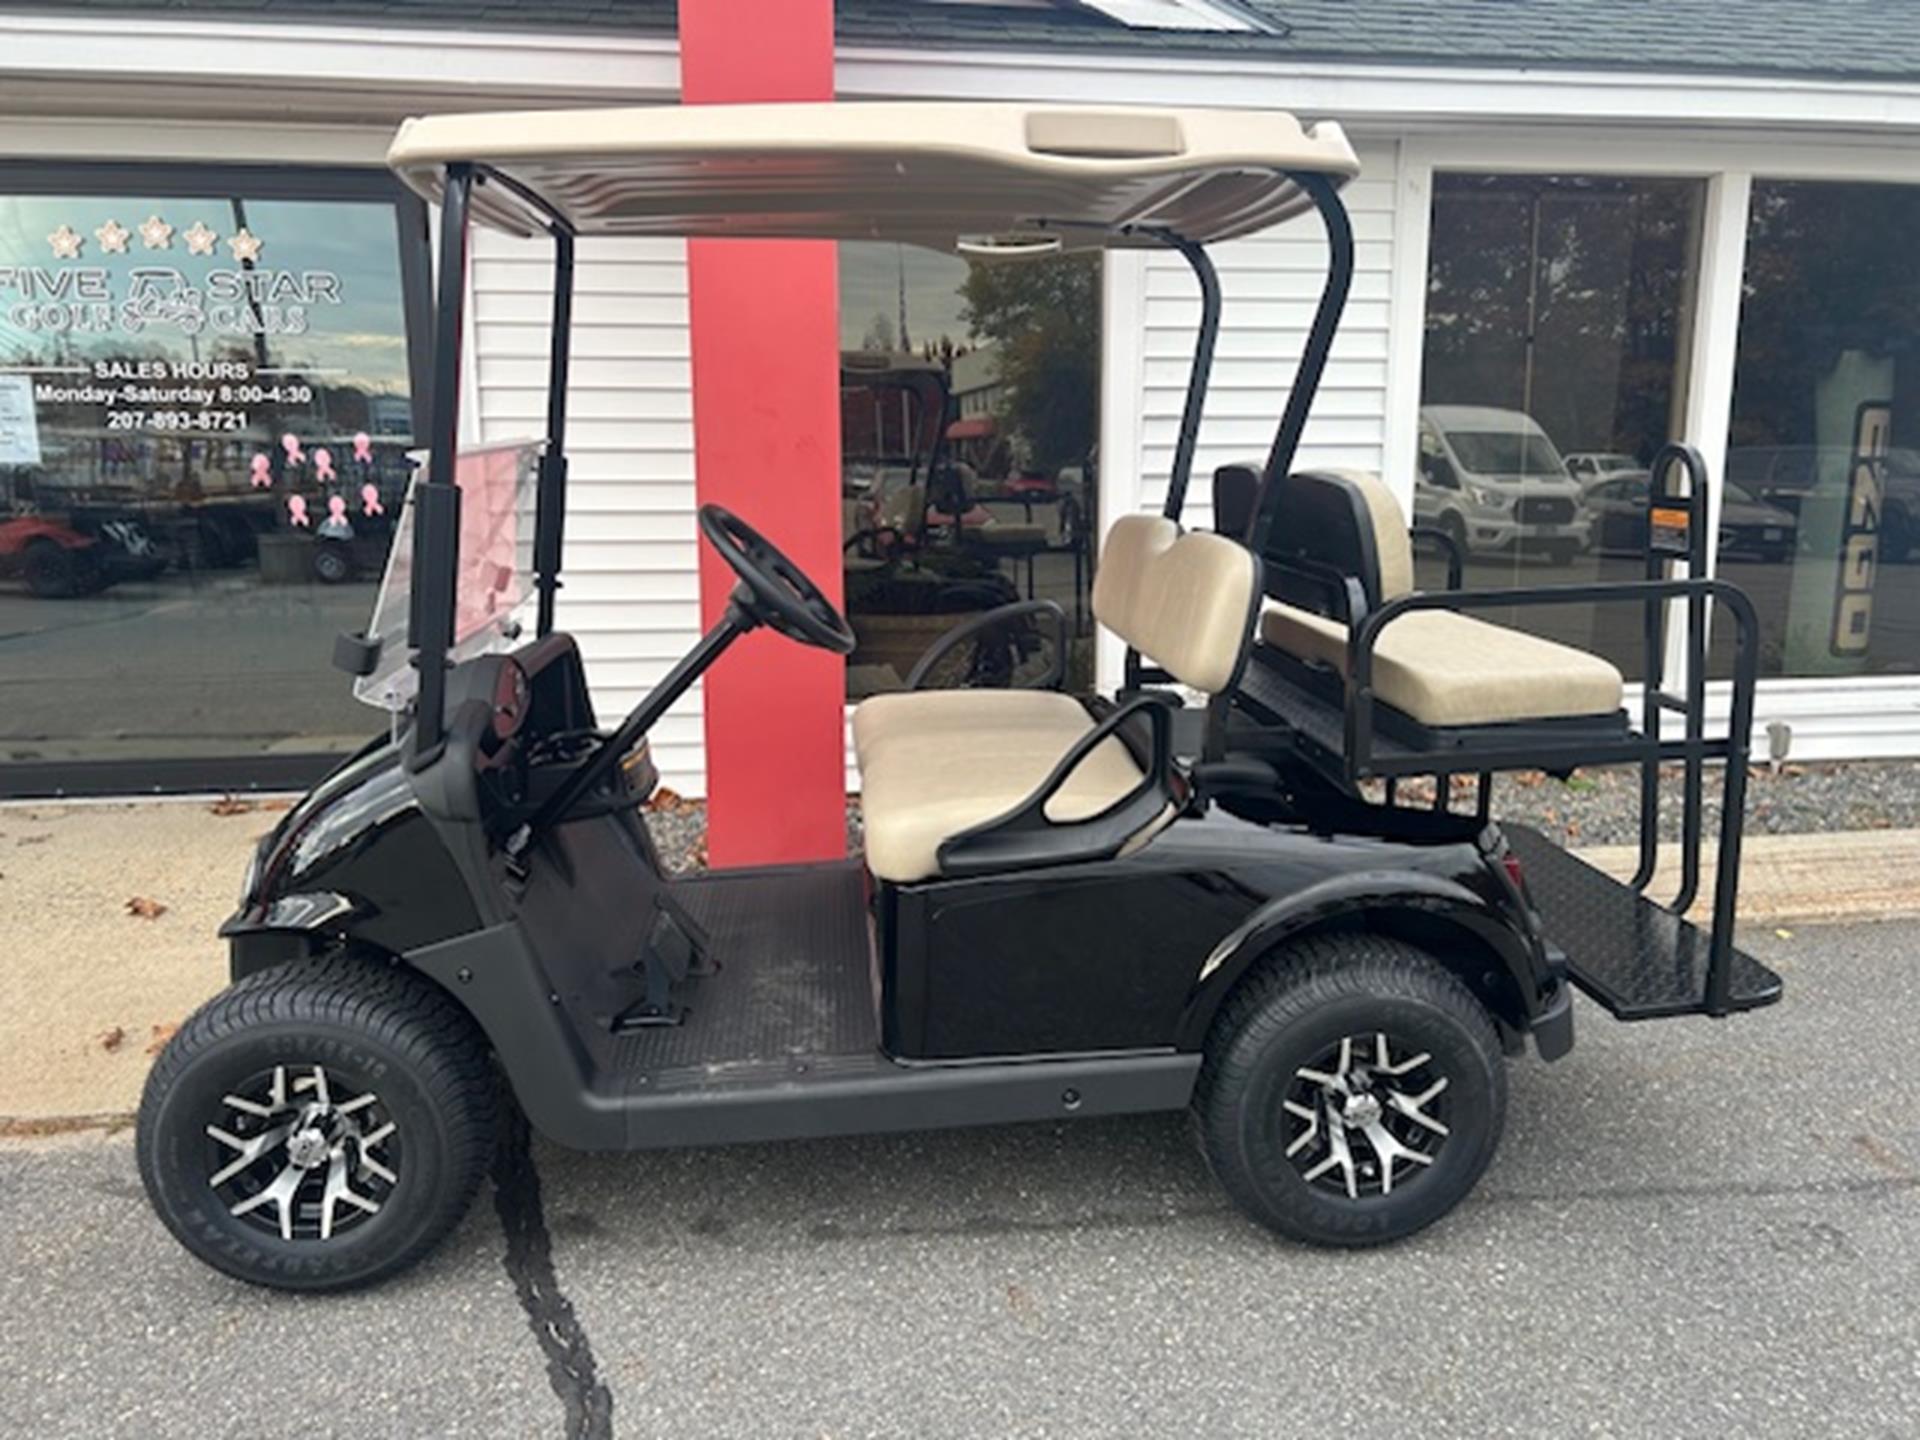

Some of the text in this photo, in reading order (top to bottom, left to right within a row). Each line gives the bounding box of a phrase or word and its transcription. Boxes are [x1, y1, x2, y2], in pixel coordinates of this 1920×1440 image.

[206, 269, 342, 303] STAR
[209, 305, 308, 334] CARS
[95, 361, 249, 380] SALES HOURS
[35, 384, 312, 406] Monday-Saturday 8:00-4:30
[107, 410, 248, 430] 207-893-8721
